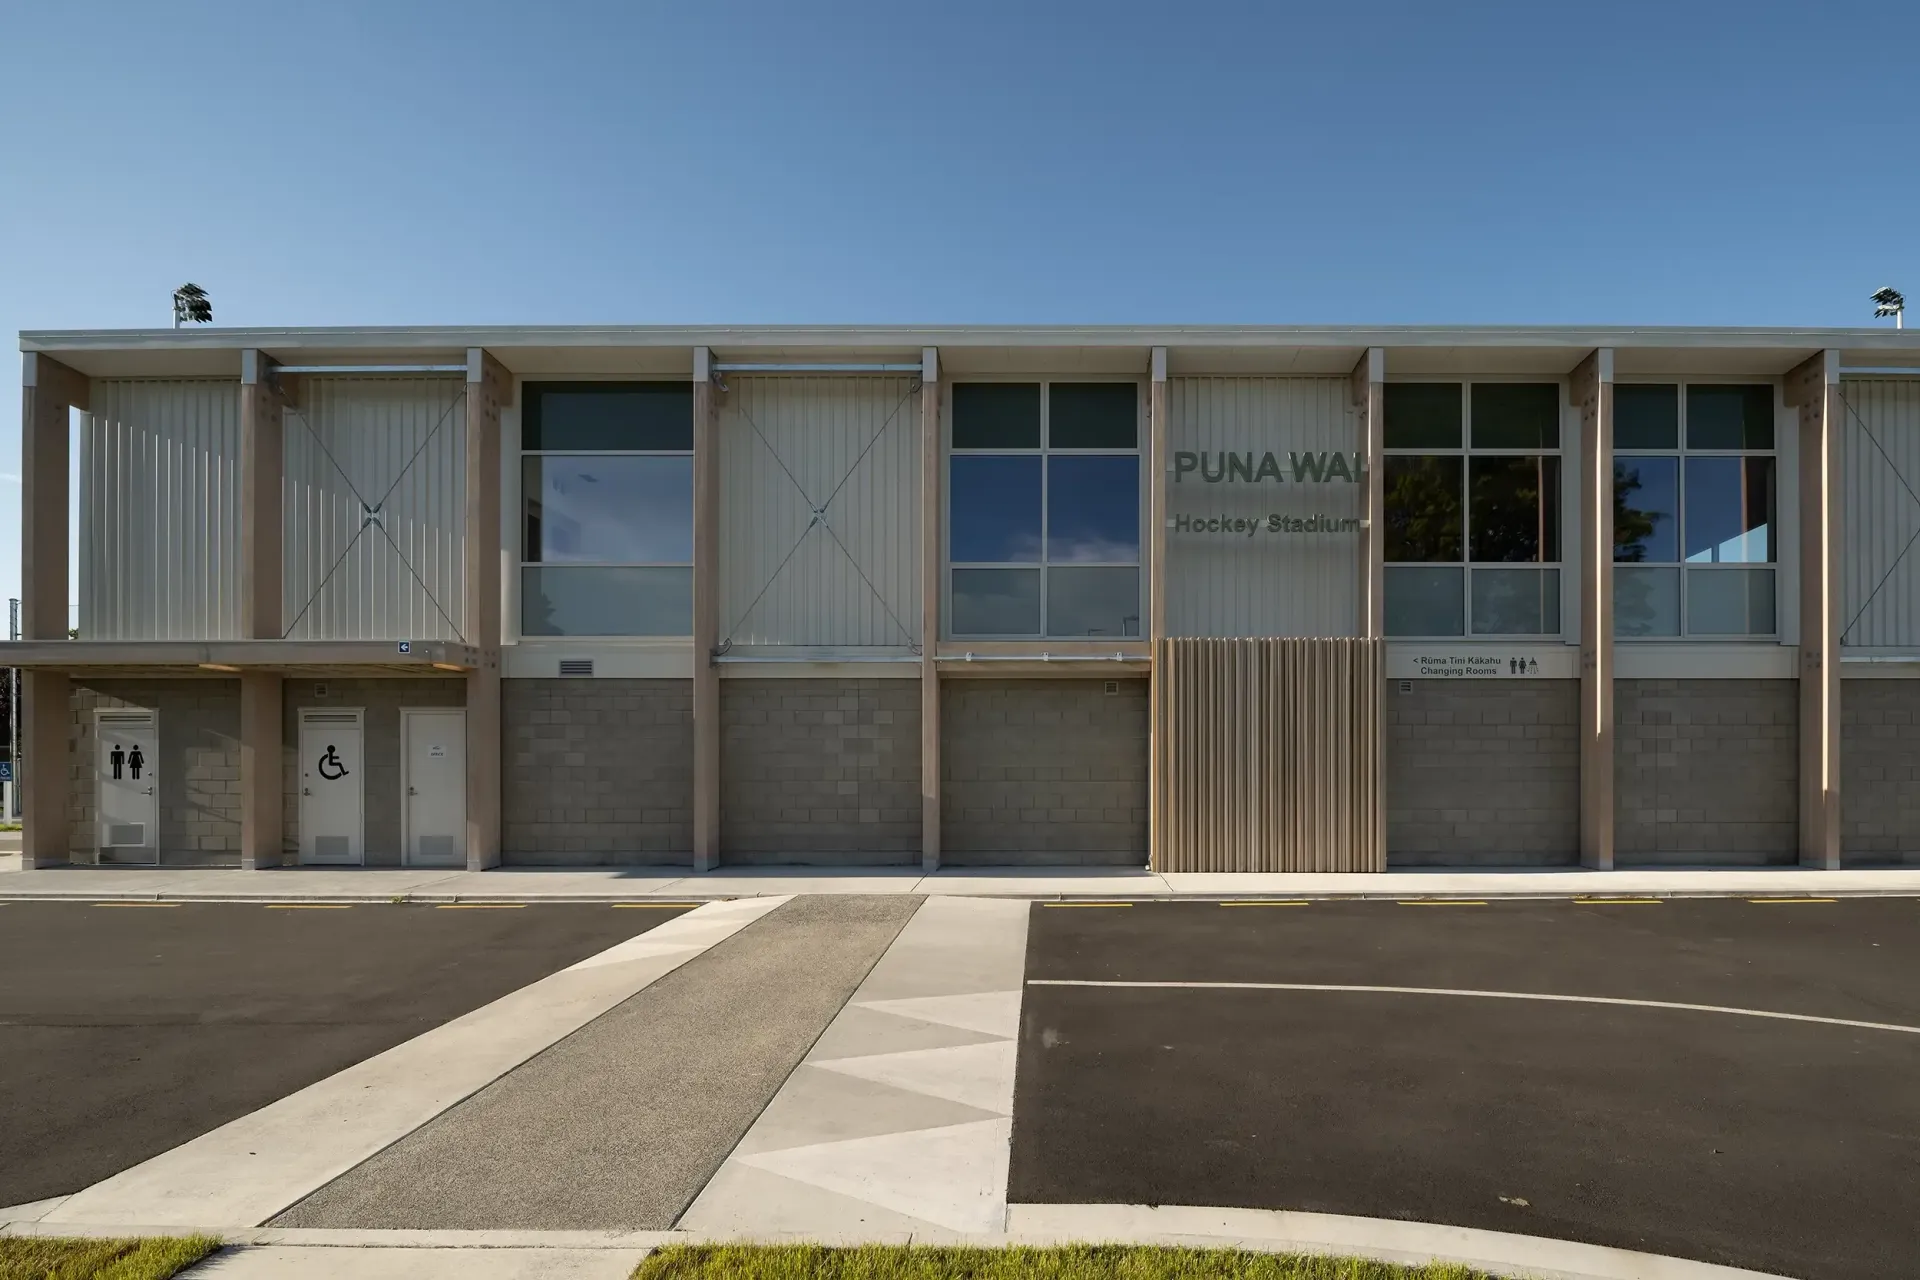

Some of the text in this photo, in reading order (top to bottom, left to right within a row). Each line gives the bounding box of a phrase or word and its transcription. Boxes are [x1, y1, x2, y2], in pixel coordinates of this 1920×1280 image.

[1174, 513, 1361, 537] Hockey Stadium
[1449, 656, 1465, 665] Tini
[1421, 667, 1497, 676] Changing Rooms
